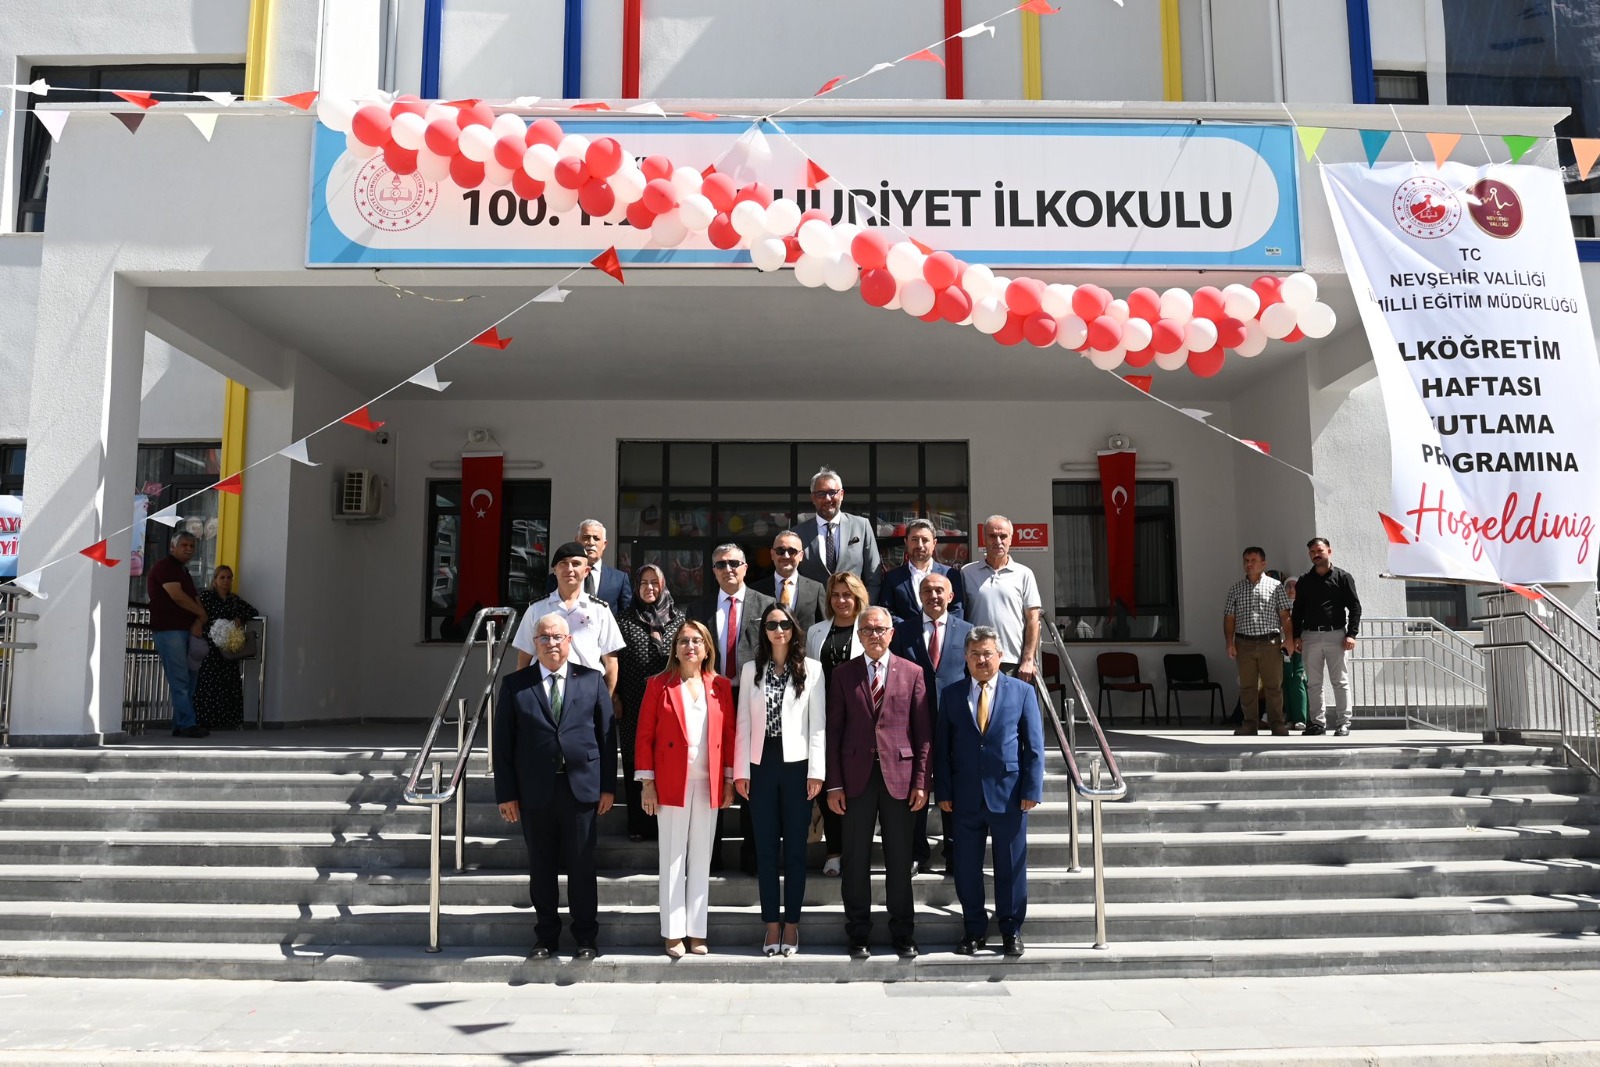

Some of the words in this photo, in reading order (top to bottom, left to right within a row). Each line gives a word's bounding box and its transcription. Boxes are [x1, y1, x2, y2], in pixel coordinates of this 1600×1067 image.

[462, 189, 560, 226] 100.
[995, 180, 1232, 229] İLKOKULU
[1459, 247, 1481, 261] TC
[1390, 268, 1480, 289] NEVŞEHİR
[1484, 269, 1546, 288] VALİLİĞİ
[1423, 292, 1482, 310] EĞİTİM
[1487, 293, 1578, 314] MÜDÜRLÜĞÜ
[1398, 334, 1561, 361] LKÖĞRETİM
[1422, 376, 1542, 398] HAFTASI
[1421, 443, 1579, 473] PRGRAMINA
